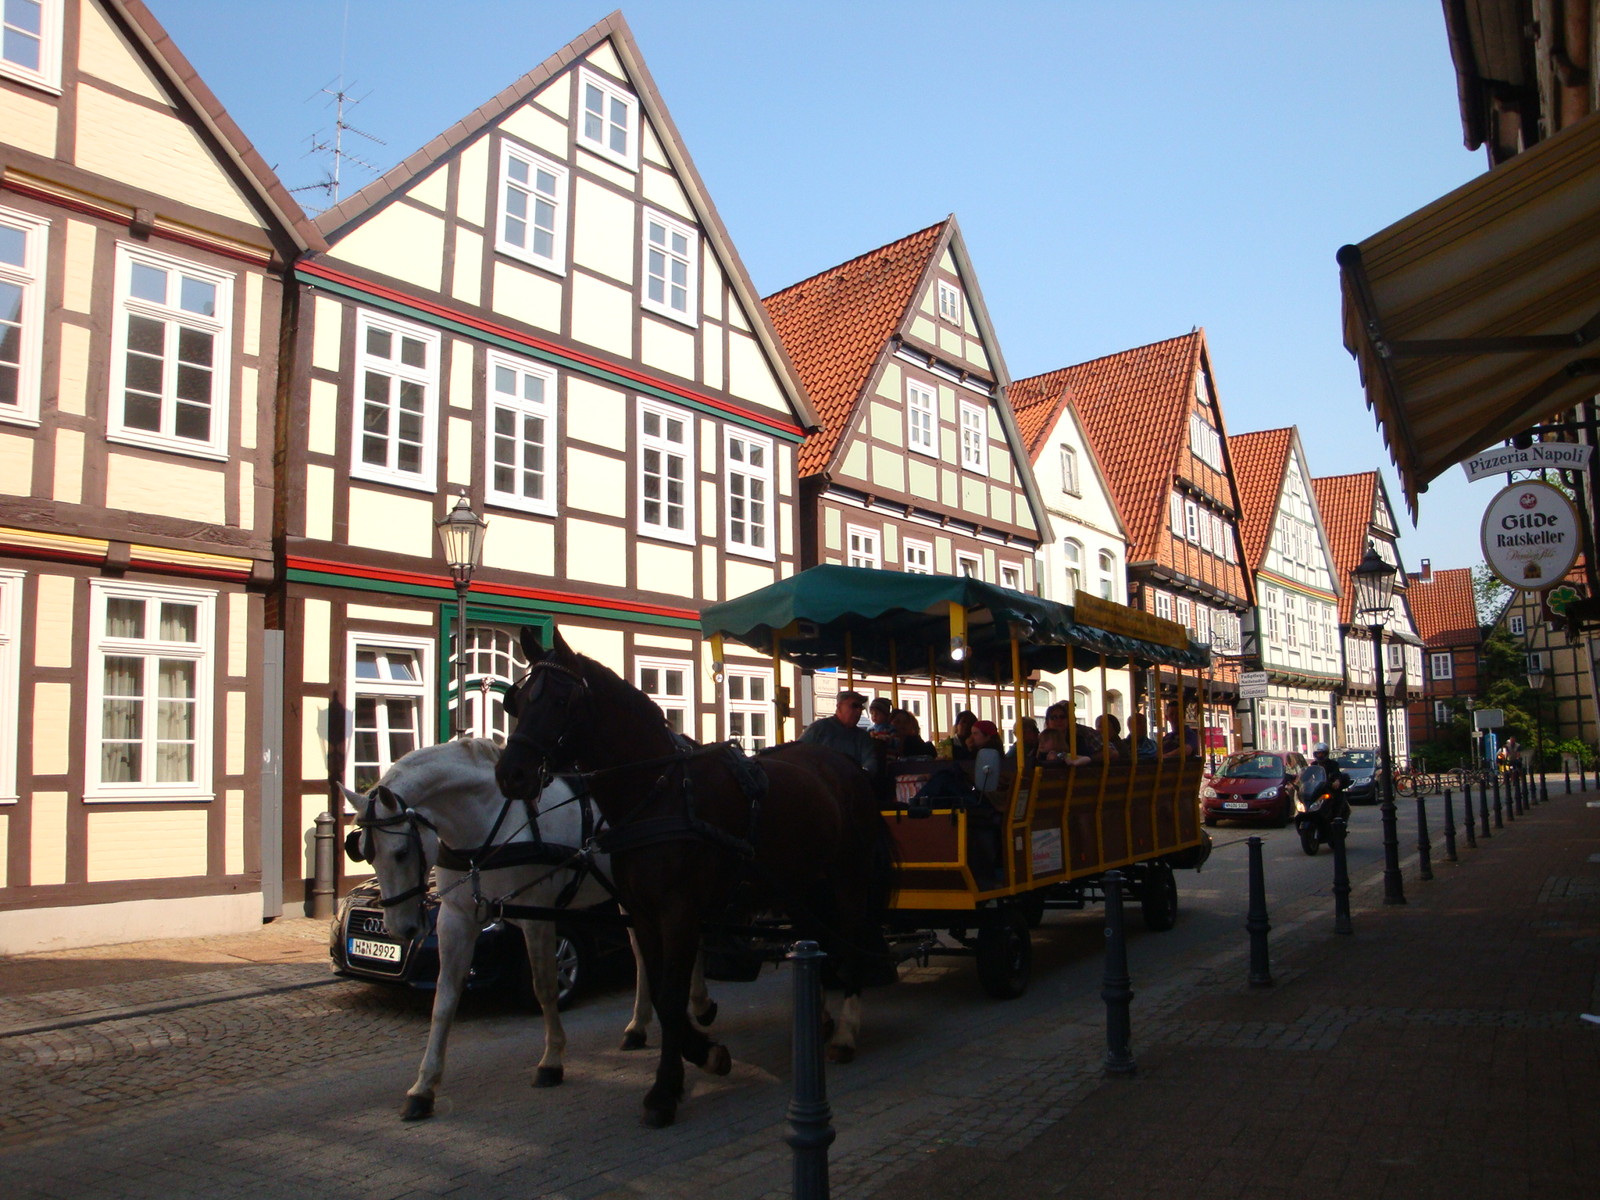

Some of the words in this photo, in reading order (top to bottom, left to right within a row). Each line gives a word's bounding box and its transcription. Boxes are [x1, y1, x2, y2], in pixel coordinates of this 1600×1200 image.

[1469, 450, 1528, 475] Pizzeria
[1532, 446, 1583, 463] Napoli
[1501, 512, 1558, 530] Gilde
[1497, 531, 1565, 548] Ratskeller
